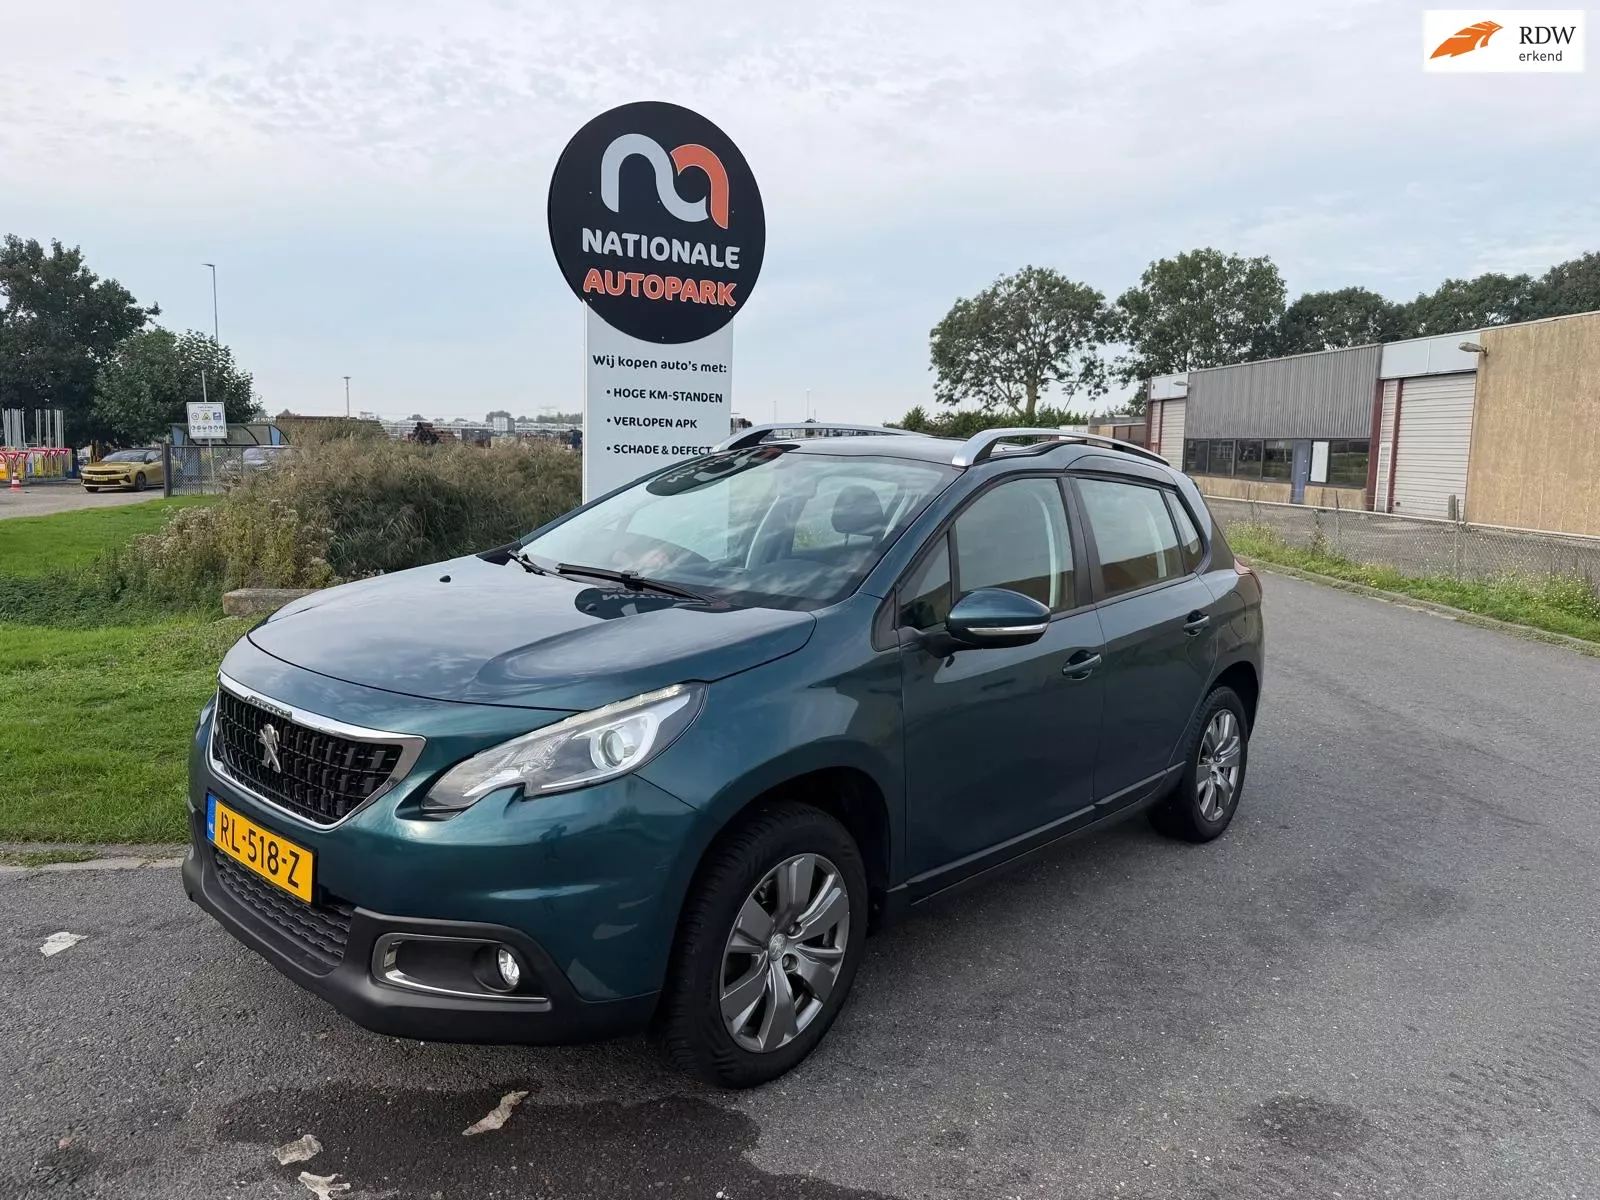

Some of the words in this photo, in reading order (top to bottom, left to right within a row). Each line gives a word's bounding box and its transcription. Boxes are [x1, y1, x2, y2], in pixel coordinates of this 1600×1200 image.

[582, 227, 741, 270] NATIONALE
[583, 268, 737, 306] AUTOPARK
[592, 354, 615, 368] Wij
[618, 356, 658, 370] kopen
[660, 360, 698, 372] auto's
[700, 362, 727, 373] met:
[613, 388, 646, 399] HOGE
[649, 390, 723, 403] KM-STANDEN
[613, 416, 673, 428] VERLOPEN
[675, 418, 698, 429] APK
[613, 444, 659, 455] SCHADE
[661, 445, 669, 455] &
[220, 811, 300, 889] RL-518-Z
